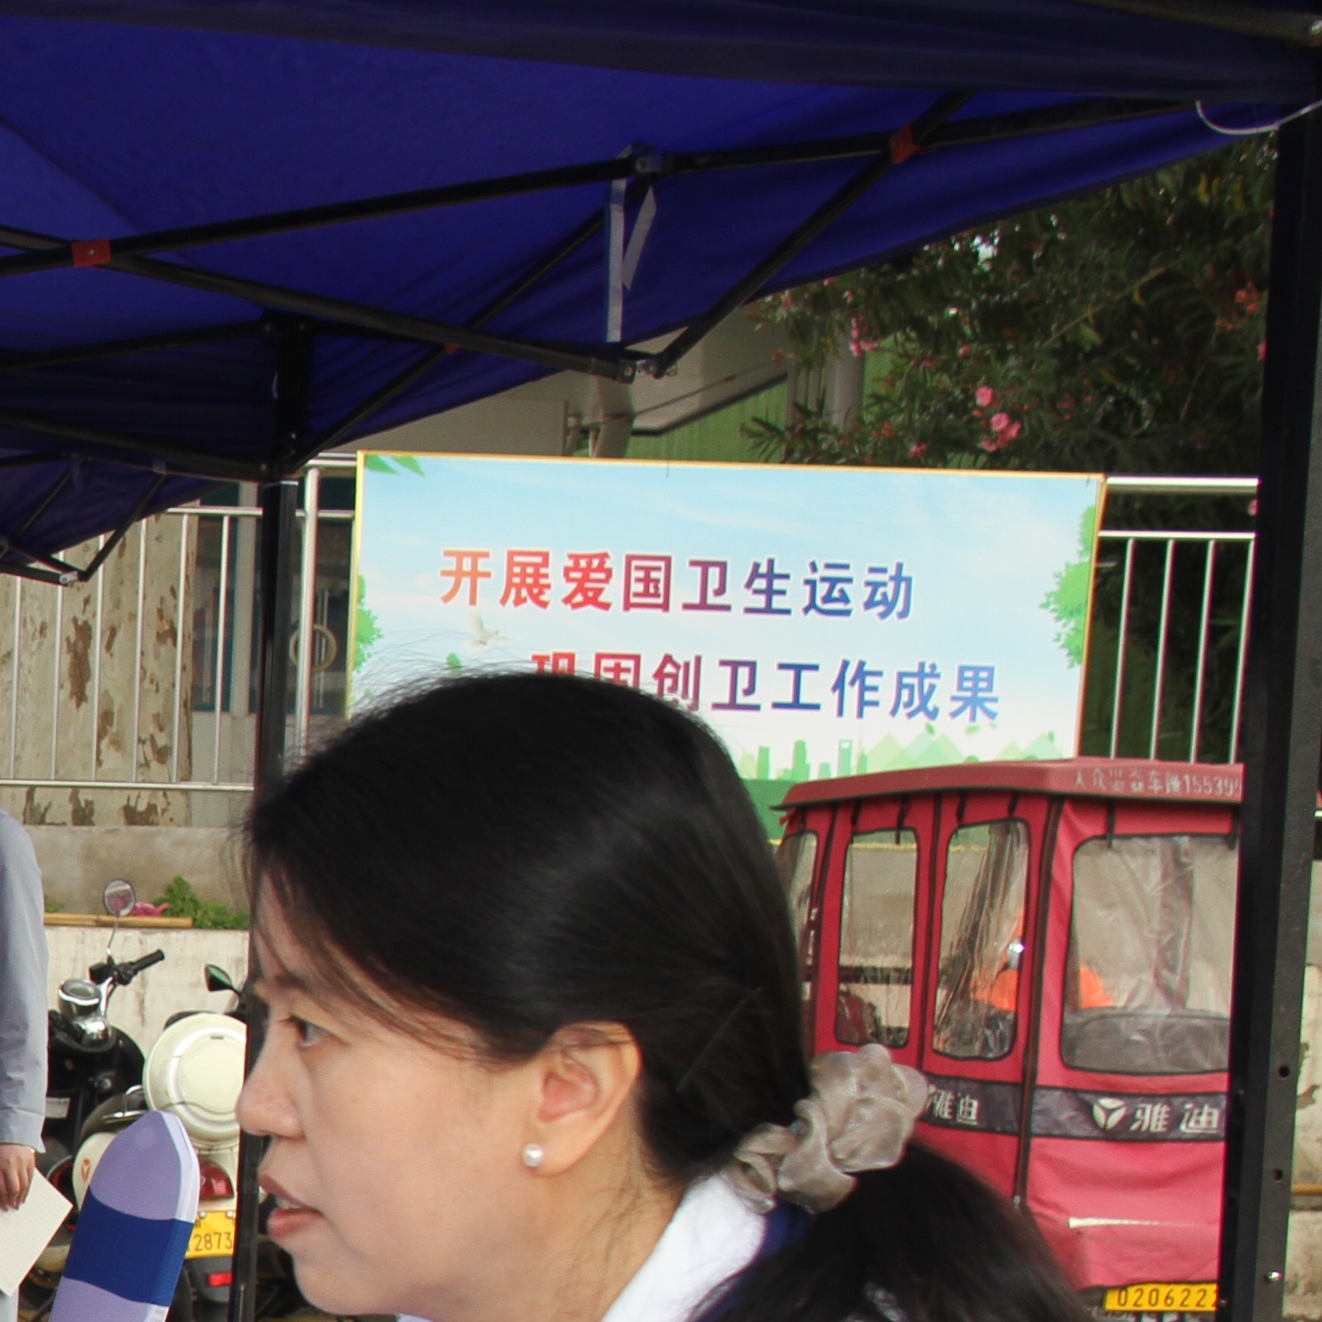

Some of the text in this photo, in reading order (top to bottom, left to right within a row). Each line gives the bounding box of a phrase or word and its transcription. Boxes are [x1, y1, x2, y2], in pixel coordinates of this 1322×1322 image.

[440, 548, 914, 620] 开展爱国卫生运动
[1130, 1103, 1220, 1133] 雅迪
